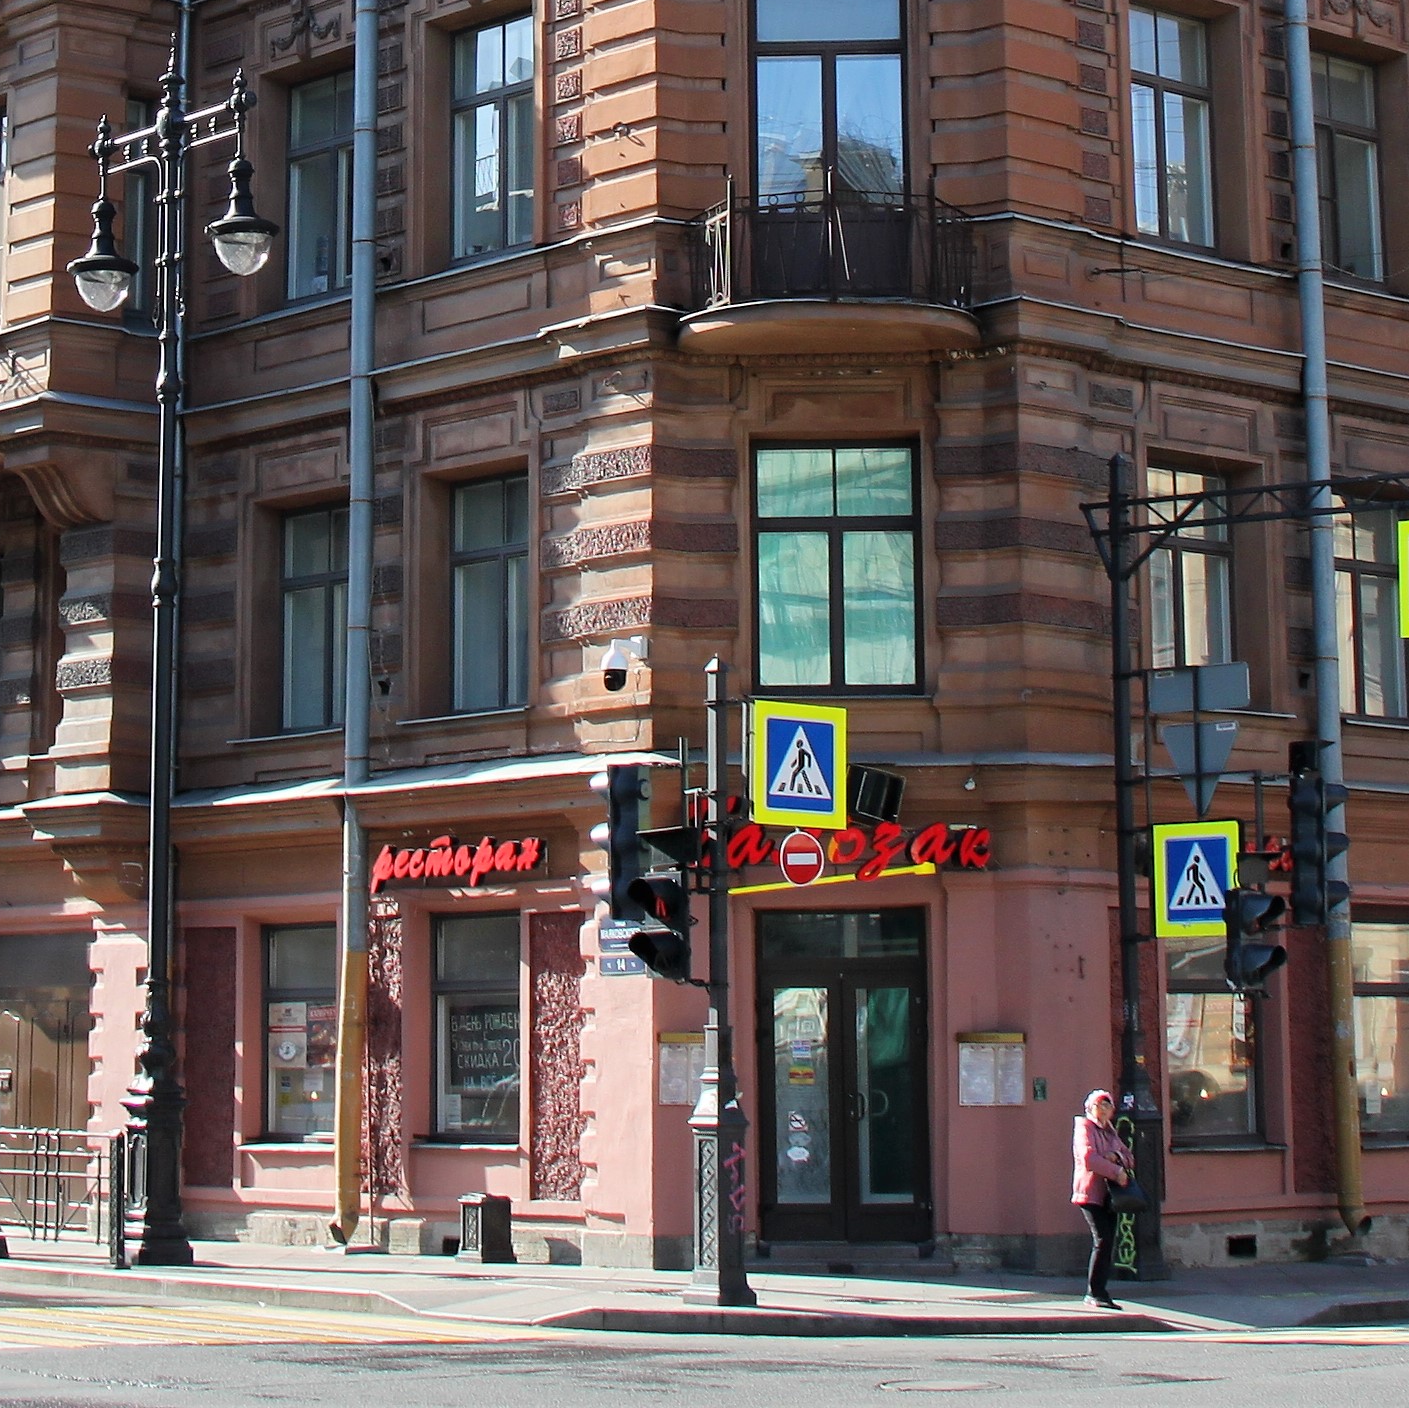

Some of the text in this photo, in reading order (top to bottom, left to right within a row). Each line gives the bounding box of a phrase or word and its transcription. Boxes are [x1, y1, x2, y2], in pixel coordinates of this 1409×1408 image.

[370, 834, 542, 895] ресторан
[616, 957, 627, 972] 14
[457, 1053, 499, 1069] СКИДКА
